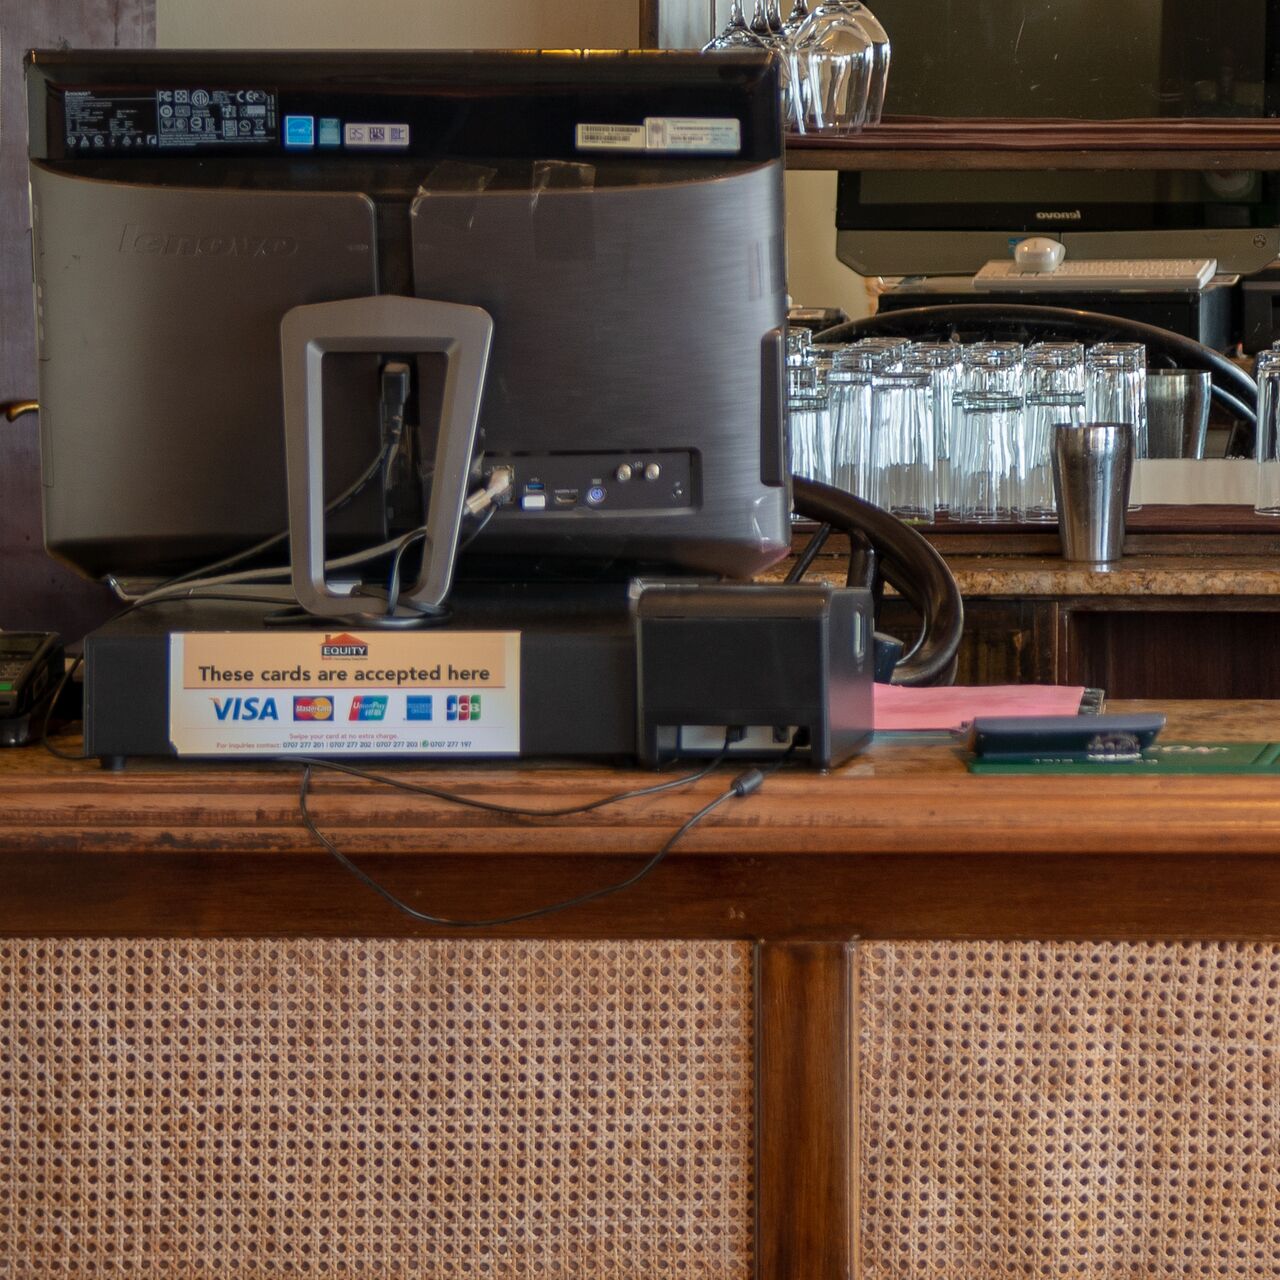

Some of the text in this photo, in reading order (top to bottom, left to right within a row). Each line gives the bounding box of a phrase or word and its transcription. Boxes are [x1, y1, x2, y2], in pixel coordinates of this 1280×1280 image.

[323, 646, 366, 656] EQUITY
[199, 664, 490, 686] These cards are accepted here
[209, 696, 280, 721] VISA
[446, 701, 482, 714] JCB
[289, 732, 308, 741] Swipe
[309, 733, 325, 741] your
[325, 732, 340, 740] card
[358, 732, 375, 740] extra
[228, 741, 255, 750] inquiries
[282, 741, 299, 749] 0707
[300, 741, 312, 749] 277
[329, 741, 346, 749] 0707
[347, 741, 359, 749] 277
[376, 741, 392, 749] 0707
[393, 741, 405, 749] 277
